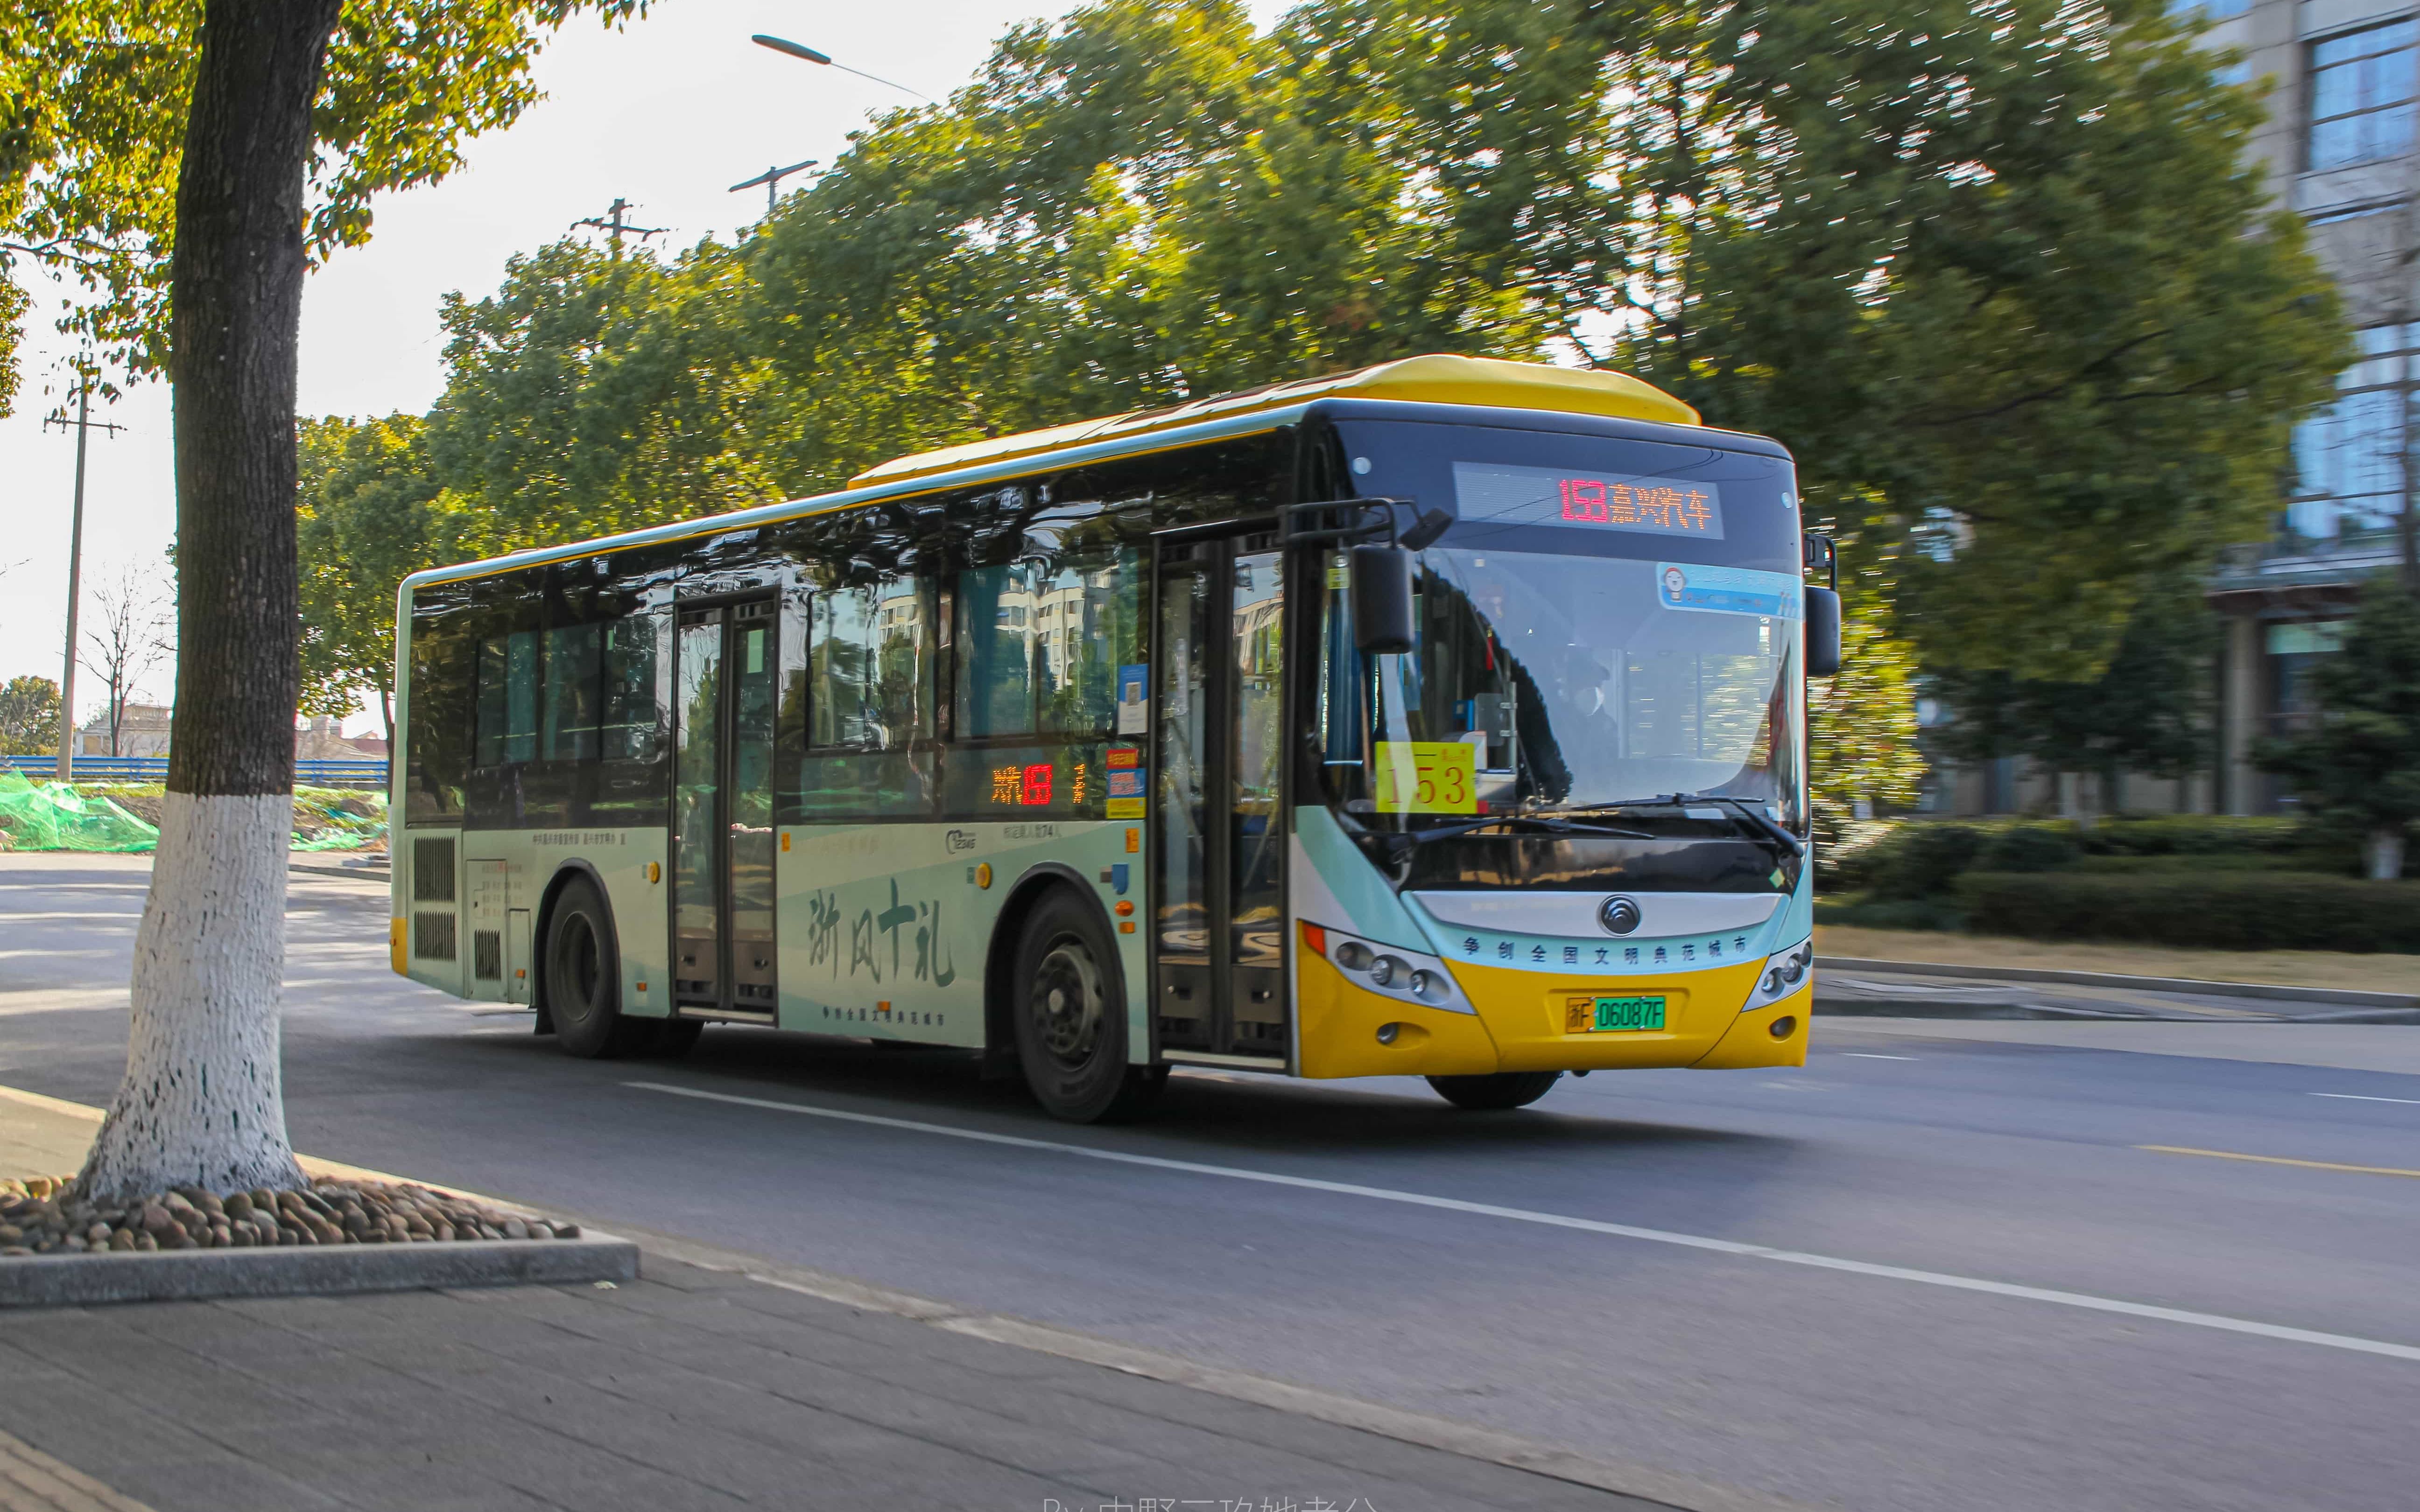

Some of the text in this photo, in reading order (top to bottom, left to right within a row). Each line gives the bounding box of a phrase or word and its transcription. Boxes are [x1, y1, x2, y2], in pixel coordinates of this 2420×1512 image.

[1559, 479, 1712, 530] 153 嘉兴汽车
[1387, 766, 1466, 804] 153
[1463, 935, 1746, 965] 争创全国文明典范城市
